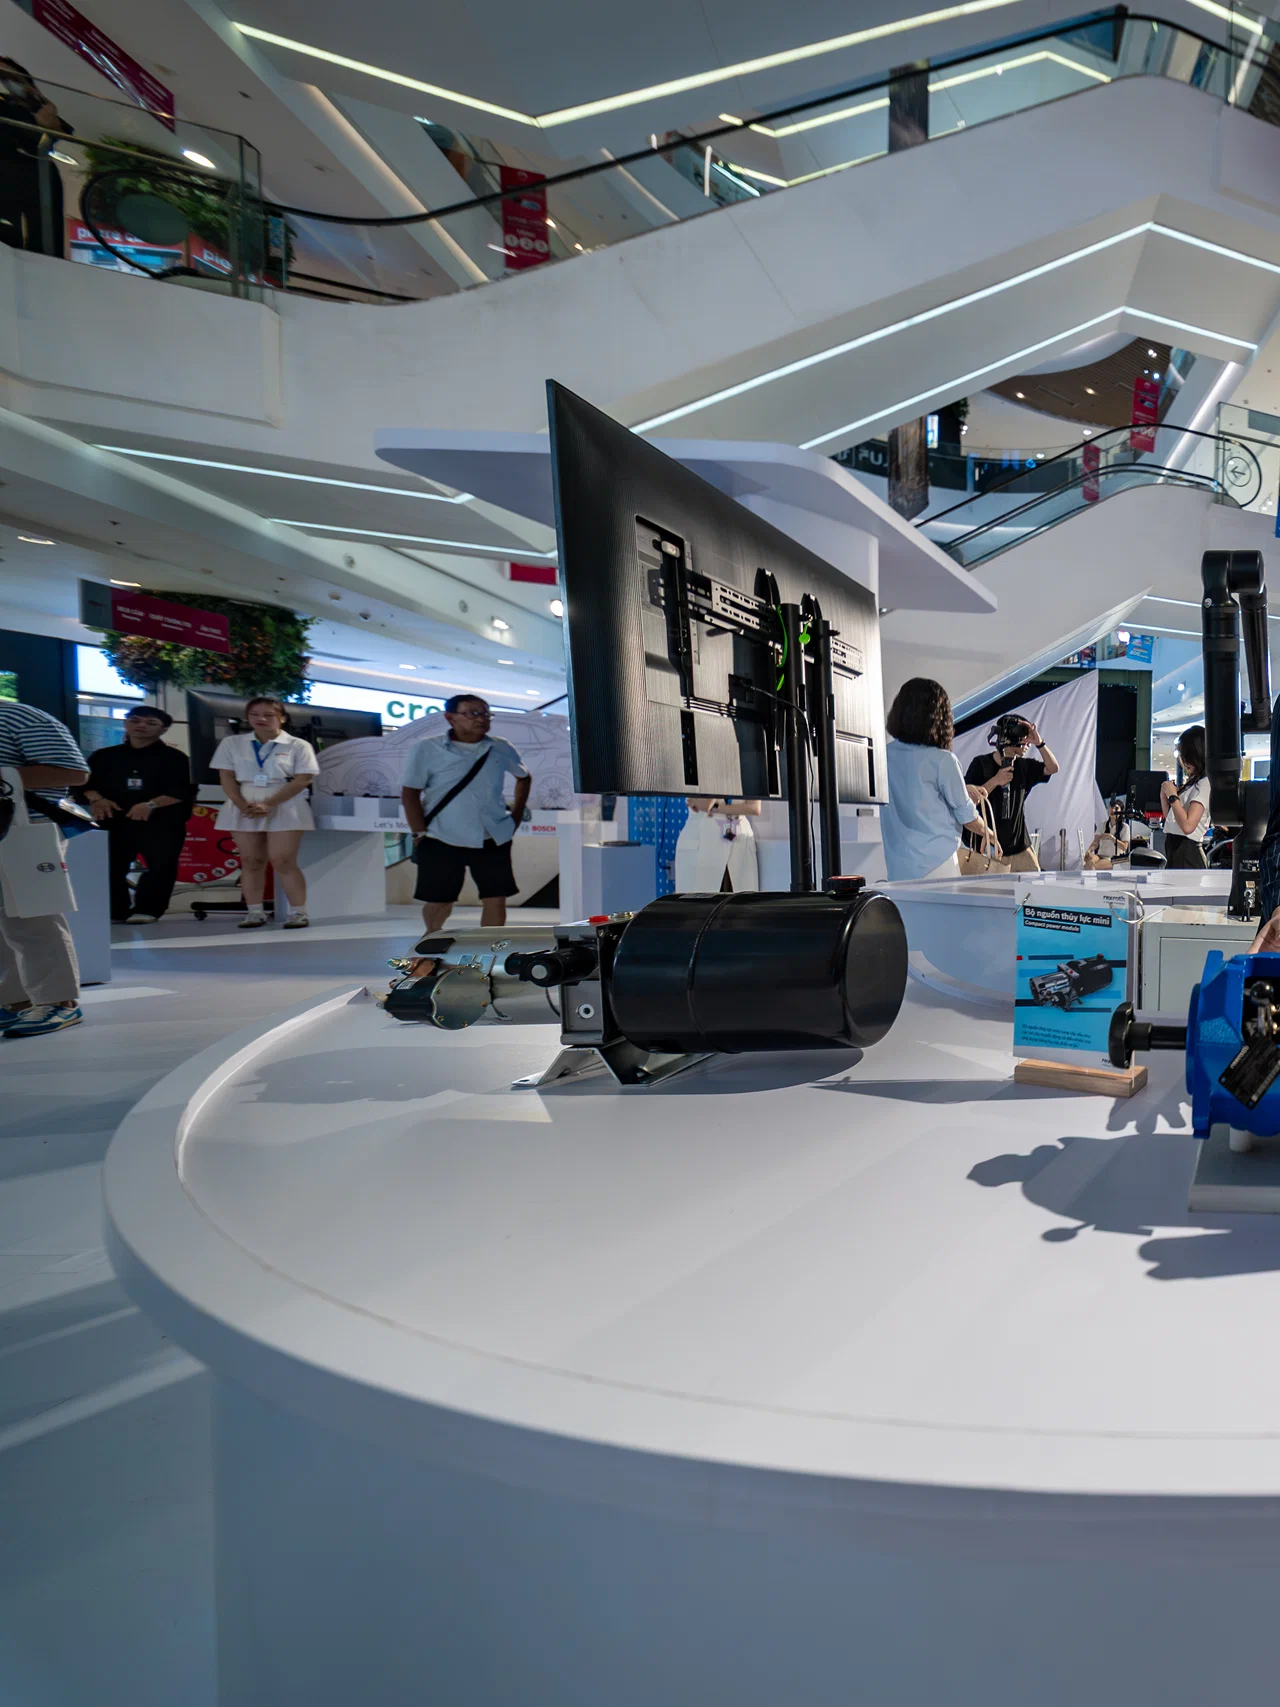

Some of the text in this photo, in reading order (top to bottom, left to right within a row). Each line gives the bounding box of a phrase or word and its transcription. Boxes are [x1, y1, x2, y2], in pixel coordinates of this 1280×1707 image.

[77, 227, 122, 241] pirre
[387, 701, 442, 720] cro
[395, 821, 409, 829] Mo
[1025, 907, 1035, 918] Bộ
[1037, 909, 1060, 920] nguồn
[1079, 914, 1091, 924] lực
[1093, 916, 1110, 925] mini
[1025, 919, 1046, 928] Compact
[1061, 924, 1079, 932] module
